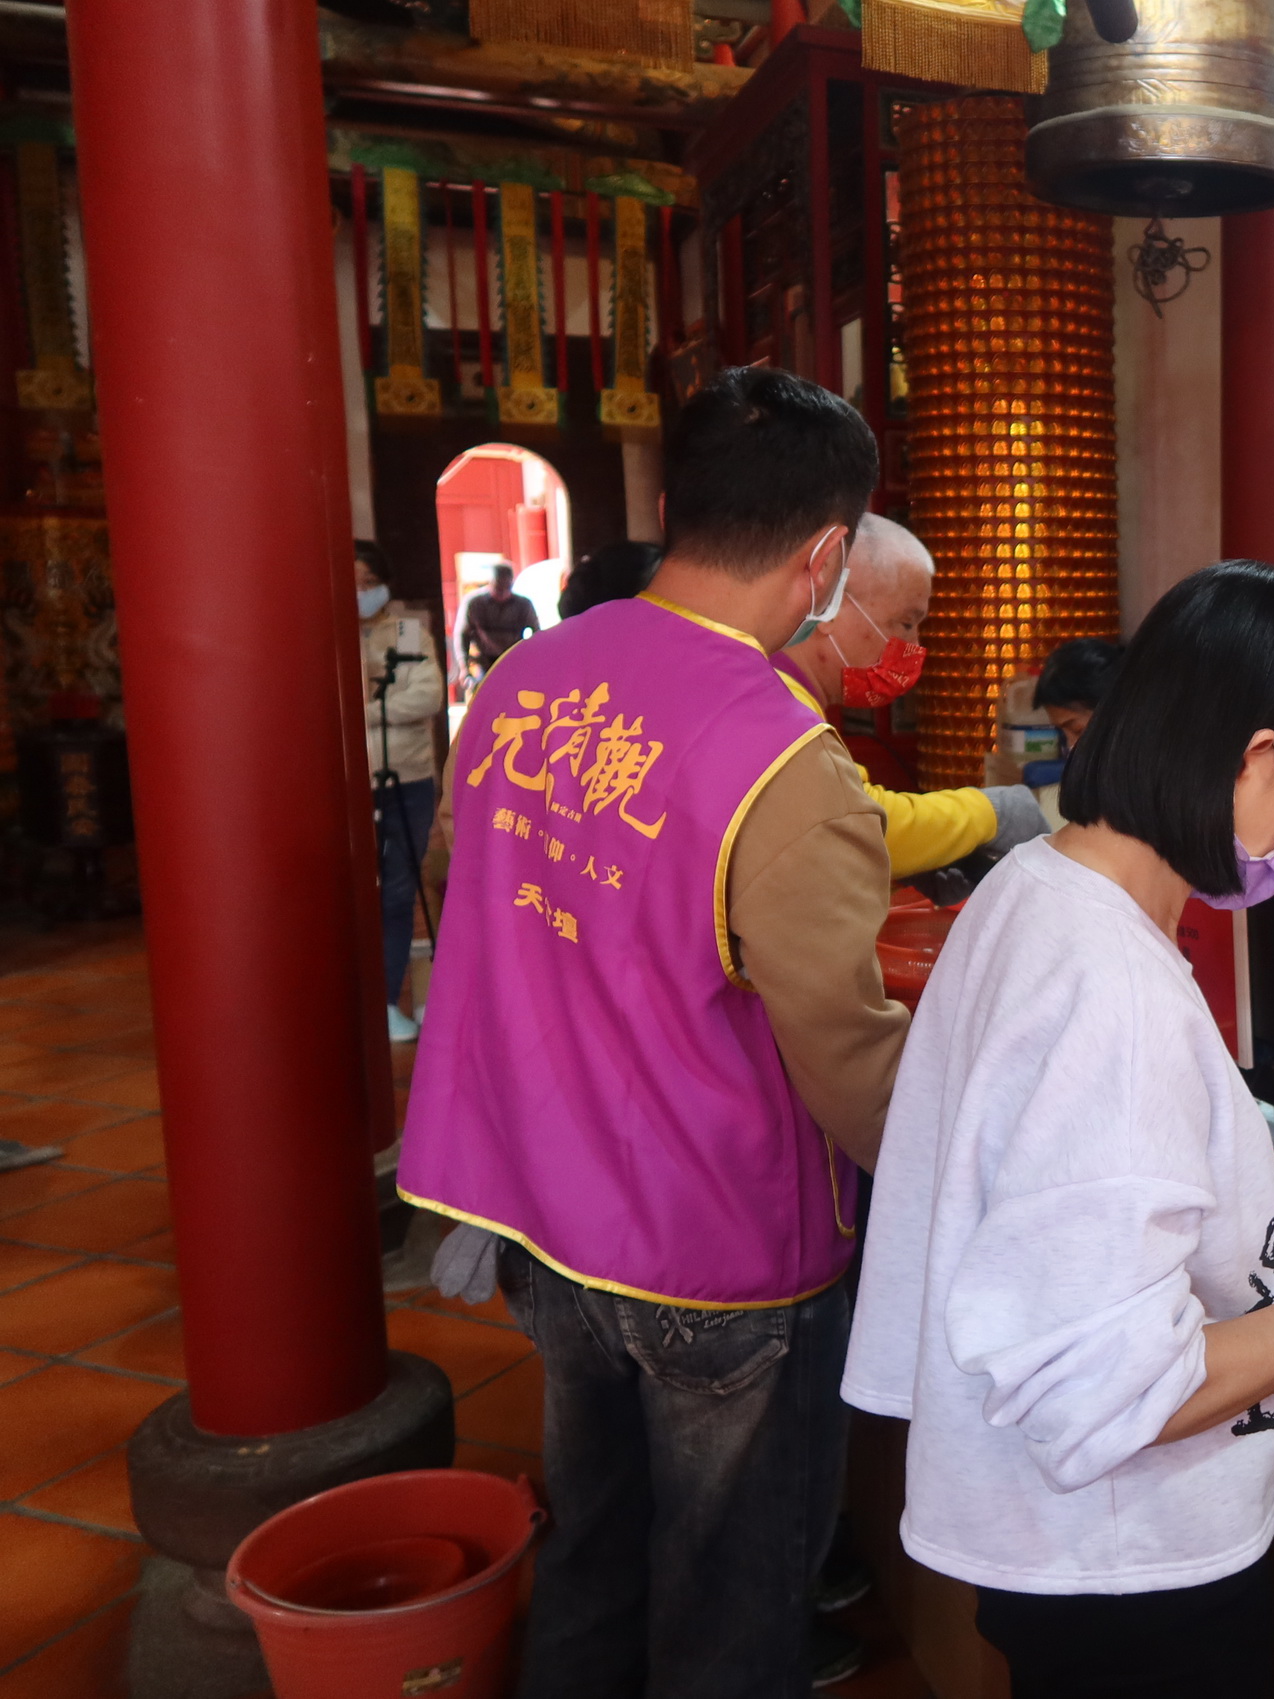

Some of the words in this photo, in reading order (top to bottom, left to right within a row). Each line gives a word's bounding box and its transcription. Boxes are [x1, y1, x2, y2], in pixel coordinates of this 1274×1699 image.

[467, 681, 667, 840] 元清觀
[513, 882, 579, 944] 天壇
